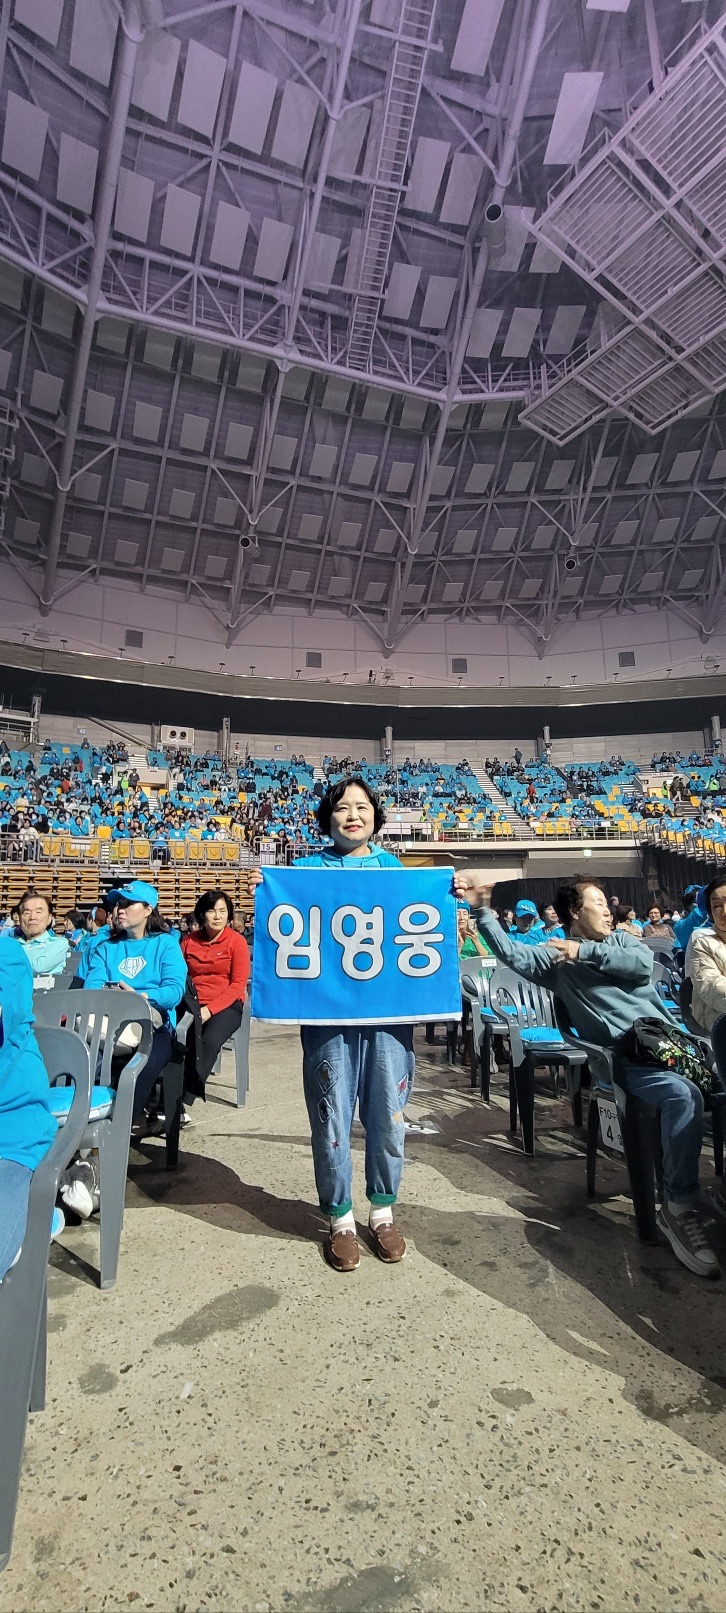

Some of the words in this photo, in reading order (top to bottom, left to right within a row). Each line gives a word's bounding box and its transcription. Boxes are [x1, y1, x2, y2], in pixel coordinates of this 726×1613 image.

[262, 843, 271, 851] 15
[267, 902, 445, 981] 임영웅
[606, 1124, 614, 1142] 4
